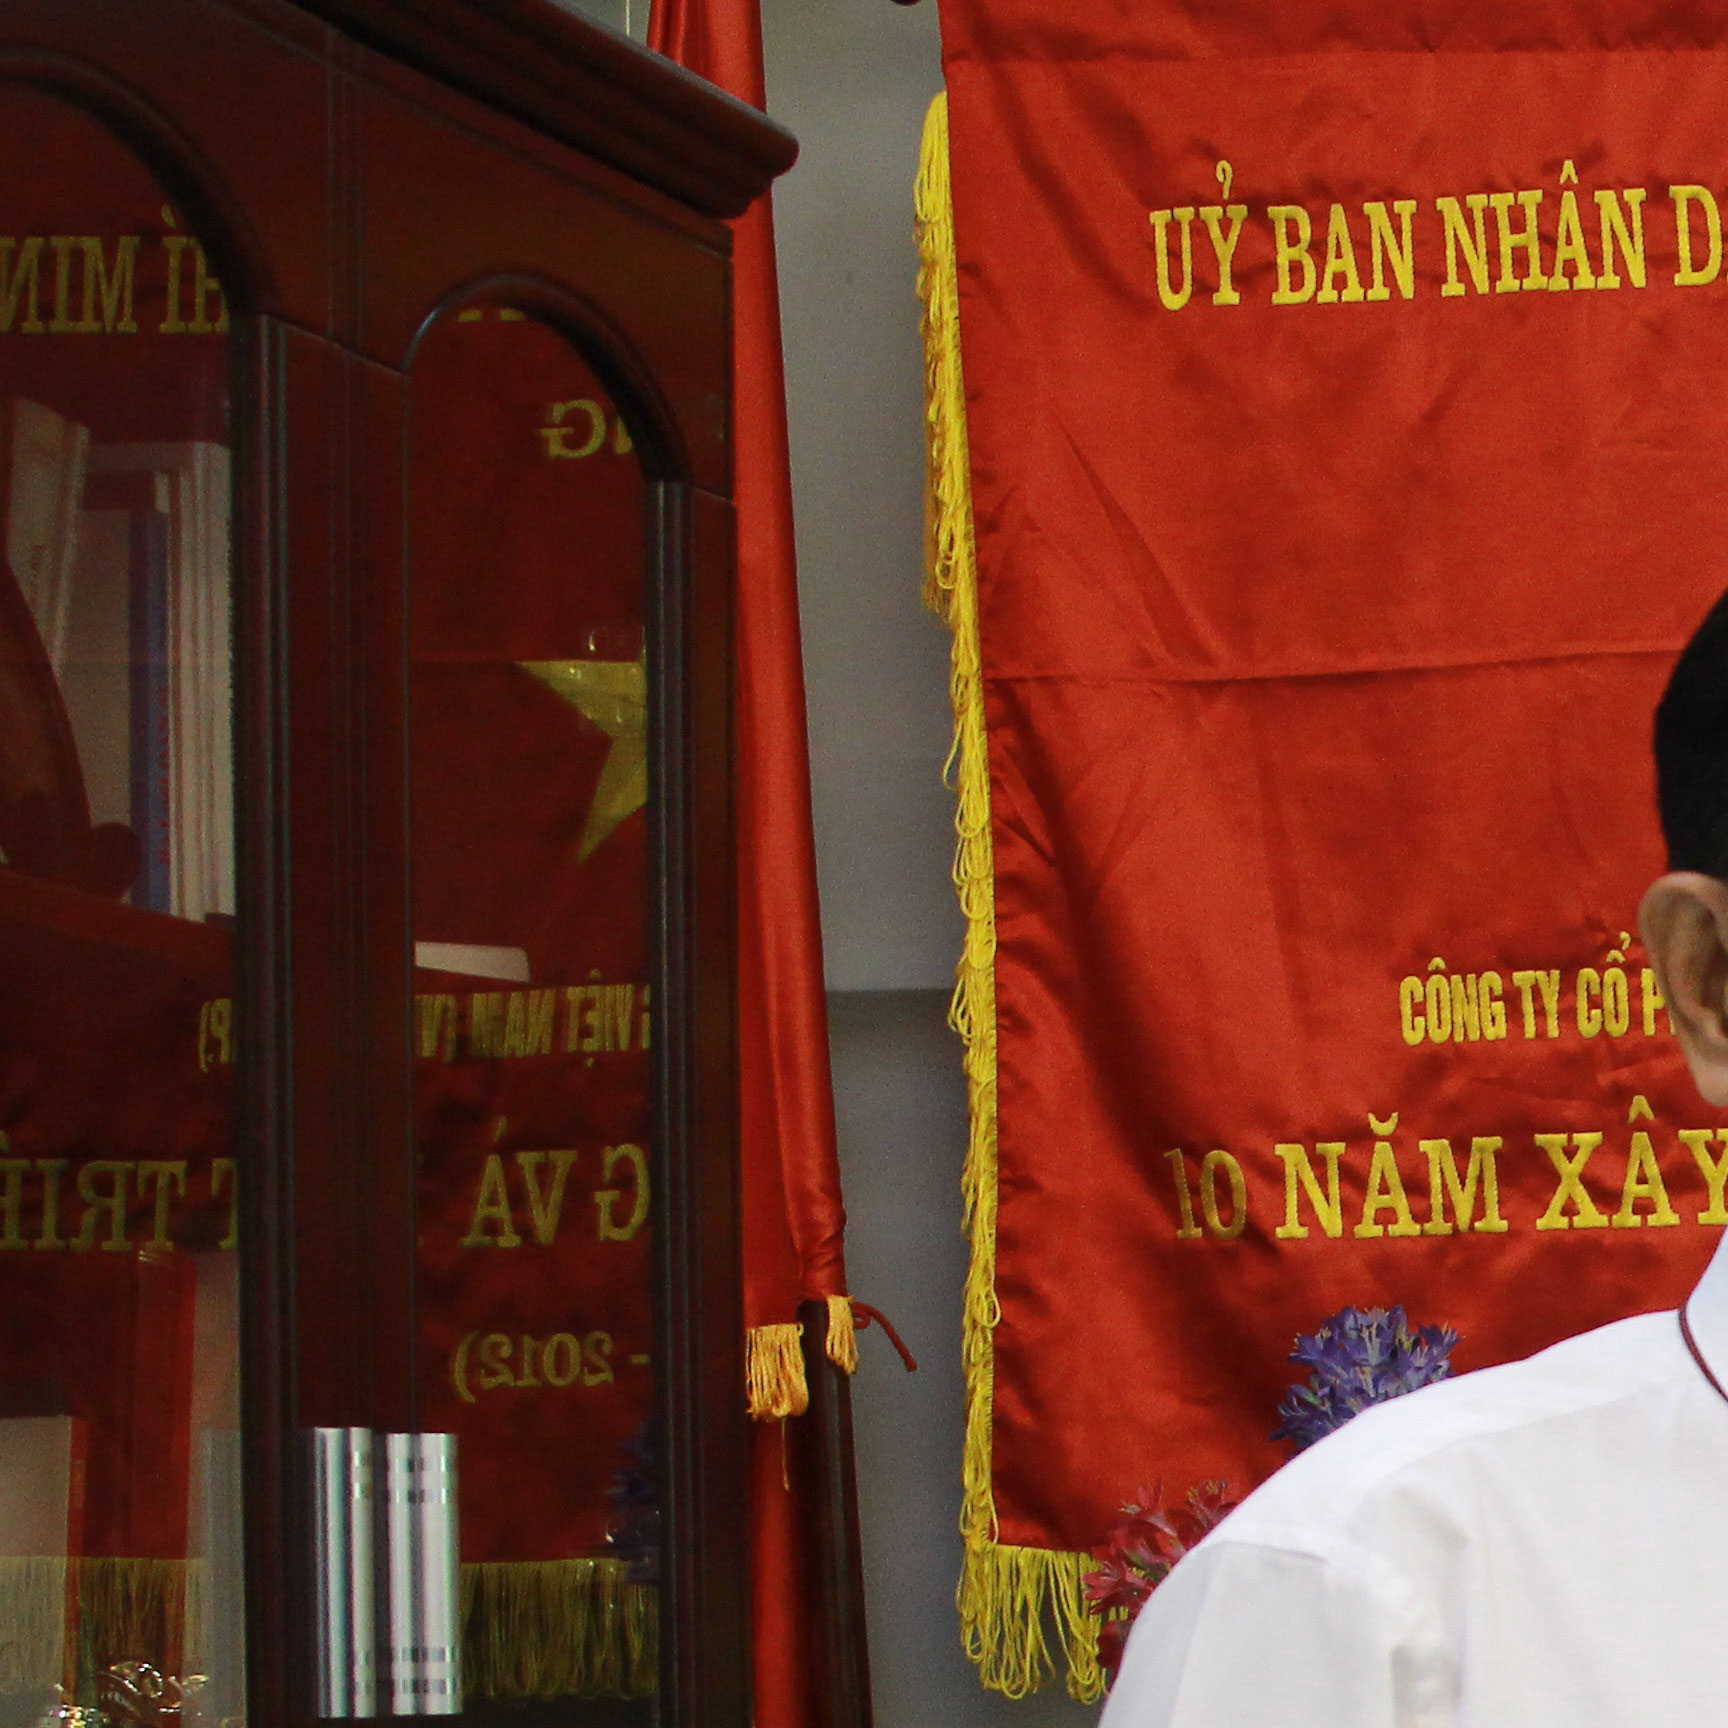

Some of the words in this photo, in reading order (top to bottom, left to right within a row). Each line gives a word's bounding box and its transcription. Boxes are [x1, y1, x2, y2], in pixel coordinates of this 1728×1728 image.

[1267, 200, 1417, 306] BAN
[1436, 159, 1647, 298] NHÂN
[1399, 957, 1506, 1046] CÔNG
[1512, 968, 1562, 1040] TY
[1576, 930, 1629, 1038] CỔ
[1164, 1147, 1248, 1240] 10
[1274, 1111, 1509, 1240] NĂM
